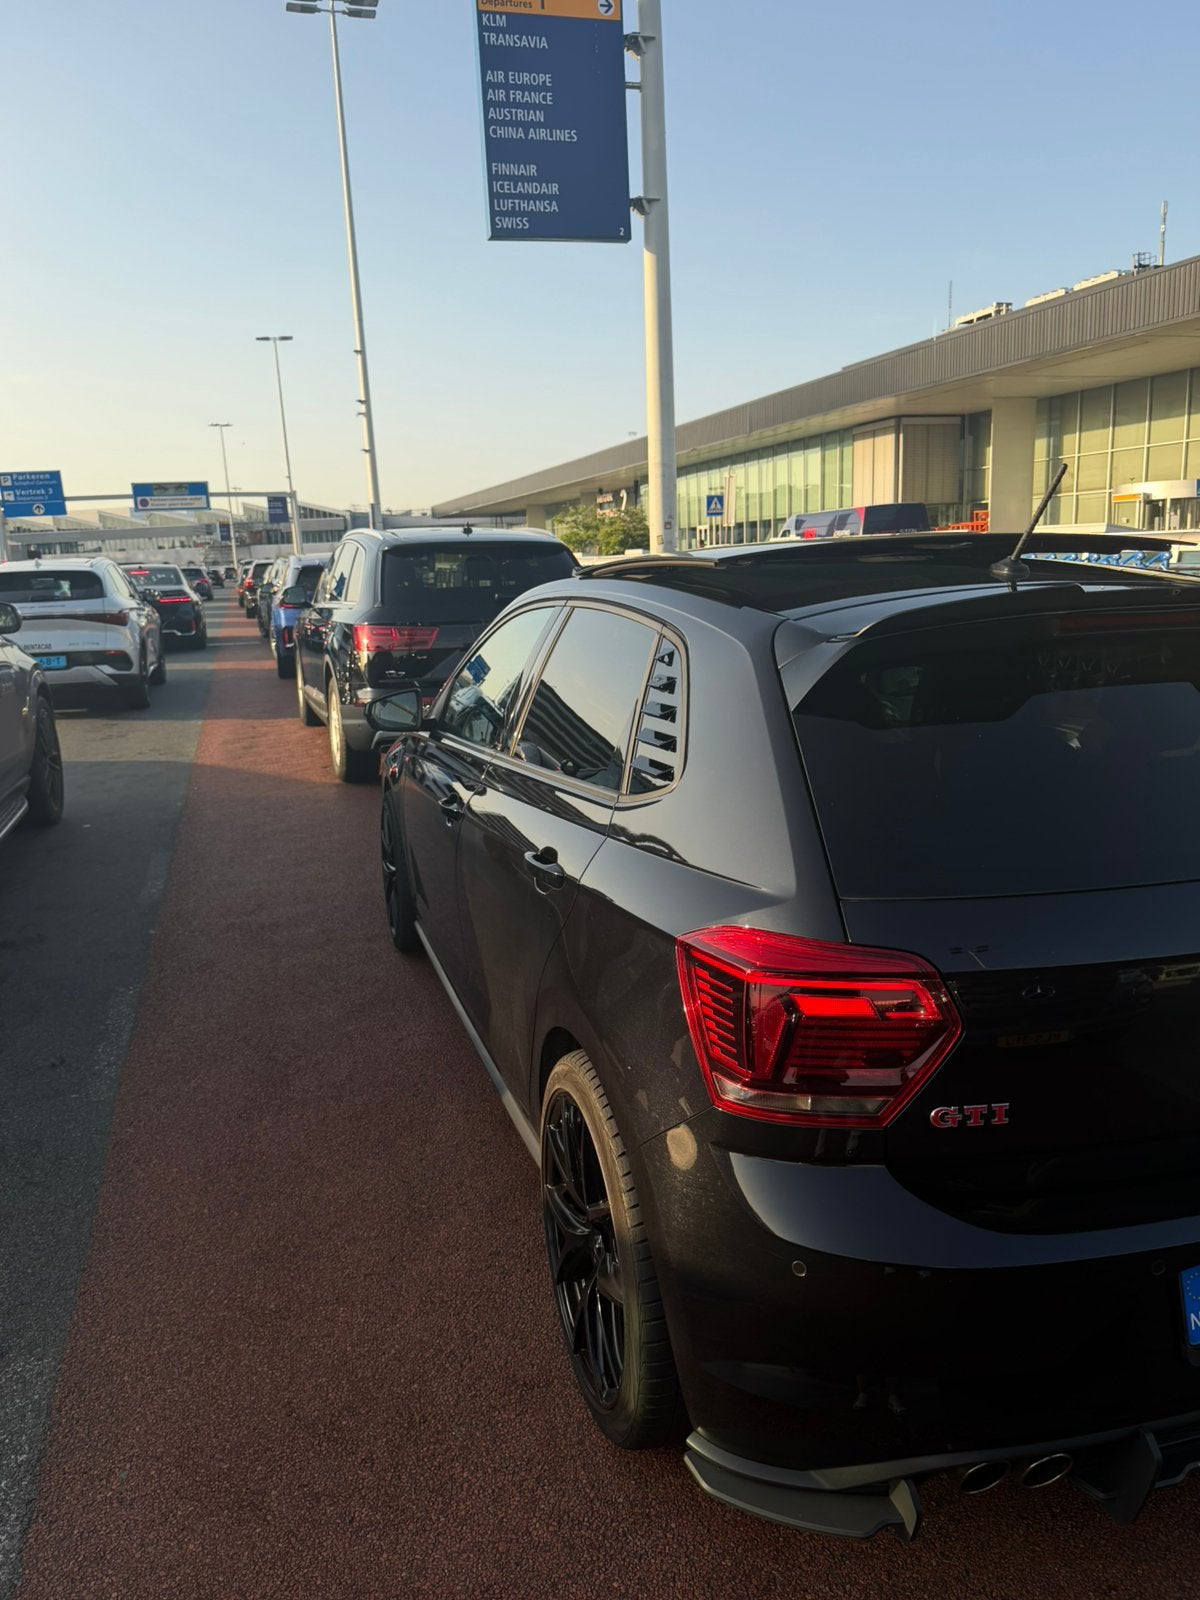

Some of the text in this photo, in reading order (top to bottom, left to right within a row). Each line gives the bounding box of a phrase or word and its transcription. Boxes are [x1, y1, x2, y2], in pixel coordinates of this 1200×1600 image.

[482, 14, 507, 27] KLM
[483, 32, 549, 49] TRANSAVIA
[486, 70, 553, 86] AIR EUROPE
[487, 89, 553, 104] AIR FRANCE
[488, 107, 545, 122] AUSTRIAN
[489, 125, 578, 142] CHINA AIRLINES
[492, 163, 537, 176] FINNAIR
[493, 181, 559, 195] ICELANDAIR
[494, 199, 559, 212] LUFTHANSA
[495, 217, 529, 229] SWISS
[619, 227, 625, 236] 2
[930, 1102, 1010, 1128] GTI
